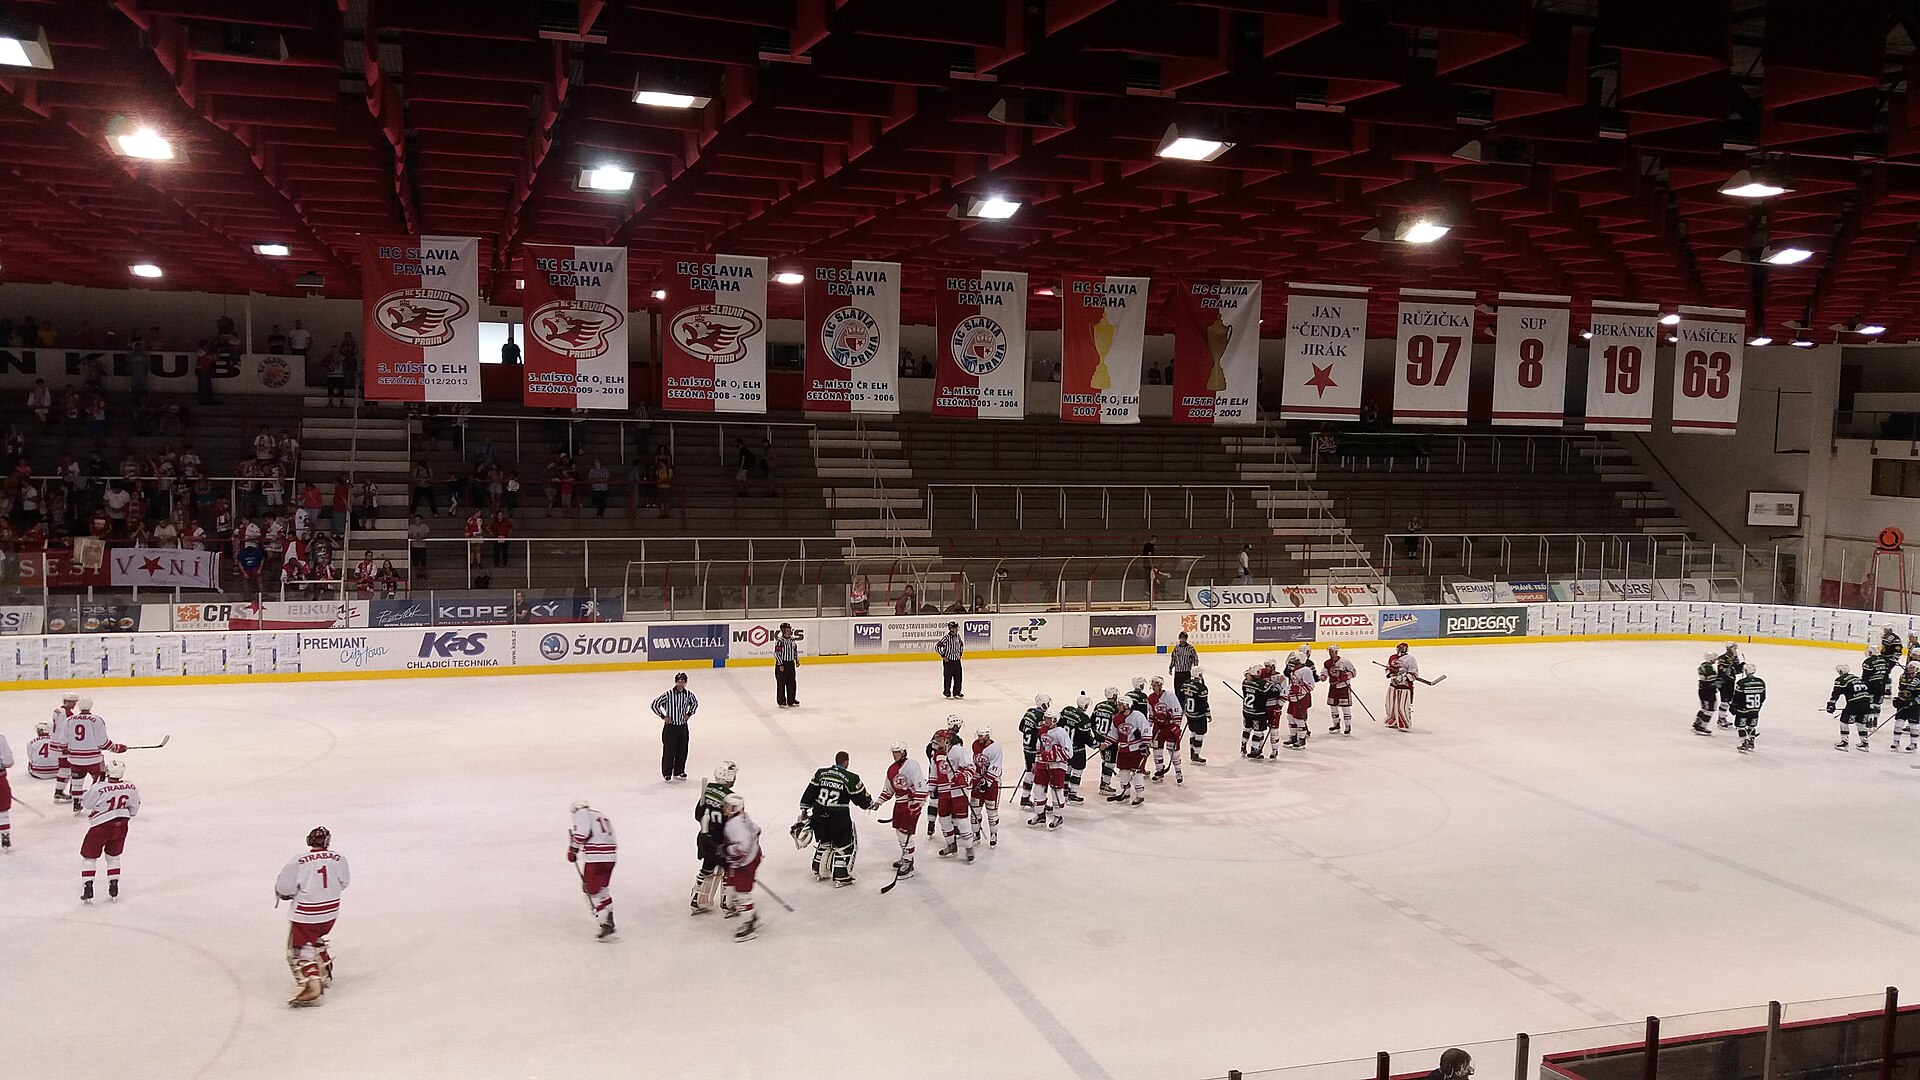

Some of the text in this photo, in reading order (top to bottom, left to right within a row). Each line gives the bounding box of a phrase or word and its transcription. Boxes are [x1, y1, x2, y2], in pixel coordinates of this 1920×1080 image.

[379, 247, 460, 260] HC SLAVIA
[393, 264, 446, 276] PRAHA
[537, 258, 614, 273] HC SLAVIA
[677, 262, 753, 278] HC SLAVIA
[550, 274, 601, 287] PRAHA
[816, 267, 887, 283] HC SLAVIA
[690, 277, 741, 292] PRAHA
[828, 282, 875, 296] PRAHA
[947, 278, 1015, 292] HC SLAVIA
[1073, 281, 1138, 295] HC SLAVIA
[1192, 284, 1248, 296] HC SLAVIA
[415, 290, 450, 301] SLAVIA
[958, 292, 1003, 305] PRAHA
[1084, 296, 1126, 308] PRAHA
[570, 300, 606, 313] SLAVIA
[1201, 298, 1238, 309] PRAHA
[710, 305, 745, 317] SLAVIA
[1312, 306, 1342, 319] JAN
[825, 310, 875, 338] HC SLAVIA
[1402, 309, 1470, 328] RŮŽIČKA
[1520, 317, 1547, 330] SUP
[955, 319, 1002, 347] HC SLAVIA
[1593, 322, 1656, 339] BERÁNEK
[1682, 327, 1738, 345] VAŠÍČEK
[850, 335, 879, 365] PRAHA
[1300, 341, 1348, 358] JIRÁK
[978, 343, 1006, 373] PRAHA
[1406, 334, 1463, 387] 97
[1517, 338, 1544, 389] 8
[378, 361, 467, 374] 3. MÍSTO ELH
[1603, 345, 1643, 395] 19
[1681, 349, 1732, 399] 63
[378, 376, 468, 386] SEZÓNA 2012/2013
[528, 372, 624, 384] 3. MÍSTO ČR ELH
[668, 377, 678, 386] 2.
[680, 376, 711, 387] MÍSTO
[715, 378, 727, 387] ČR
[743, 381, 761, 389] ELH
[813, 379, 888, 390] 2. MÍSTO ČR ELH
[529, 383, 624, 395] SEZÓNA 2009 2010
[668, 389, 705, 399] SEZÓNA
[707, 391, 730, 399] 2008
[942, 386, 1013, 397] 2. MÍSTO ČR ELH
[807, 391, 895, 402] SEZÓNA 2005 2006
[937, 397, 1019, 408] SEZÓNA 2003 2004
[1063, 393, 1139, 404] MISTR ČR ELH
[1182, 396, 1249, 406] MISTR ČR ELH
[1072, 407, 1129, 416] 2007 2008
[1188, 408, 1242, 417] 2002 2003
[1282, 586, 1318, 595] HOOTERS
[1330, 586, 1366, 595] HOOTERS
[1222, 590, 1278, 605] ŠKODA
[203, 604, 248, 622] CRS
[1255, 614, 1303, 624] KOPECKÝ
[1383, 613, 1413, 621] DELIKA
[906, 622, 937, 630] STAVEBNÍHO
[966, 622, 990, 633] Vype
[1200, 613, 1231, 632] CRS
[1447, 616, 1519, 635] RADEGAST
[856, 624, 881, 636] Vype
[1008, 627, 1039, 643] FCC
[1101, 626, 1134, 636] VARTA
[1321, 629, 1374, 637] Velkoobchod
[304, 637, 368, 650] PREMIANT
[573, 634, 648, 656] ŠKODA
[670, 636, 725, 648] WACHAL
[899, 641, 935, 650] www.vyp
[406, 658, 499, 669] CHLADICÍ TECHNIKA
[1745, 694, 1760, 709] 58
[29, 735, 51, 744] STRAB
[74, 724, 86, 742] 9
[39, 742, 49, 758] 4
[98, 783, 136, 796] STRABAG
[105, 794, 130, 812] 16
[818, 788, 840, 806] 92
[298, 852, 341, 865] STRABAG
[317, 865, 328, 889] 1
